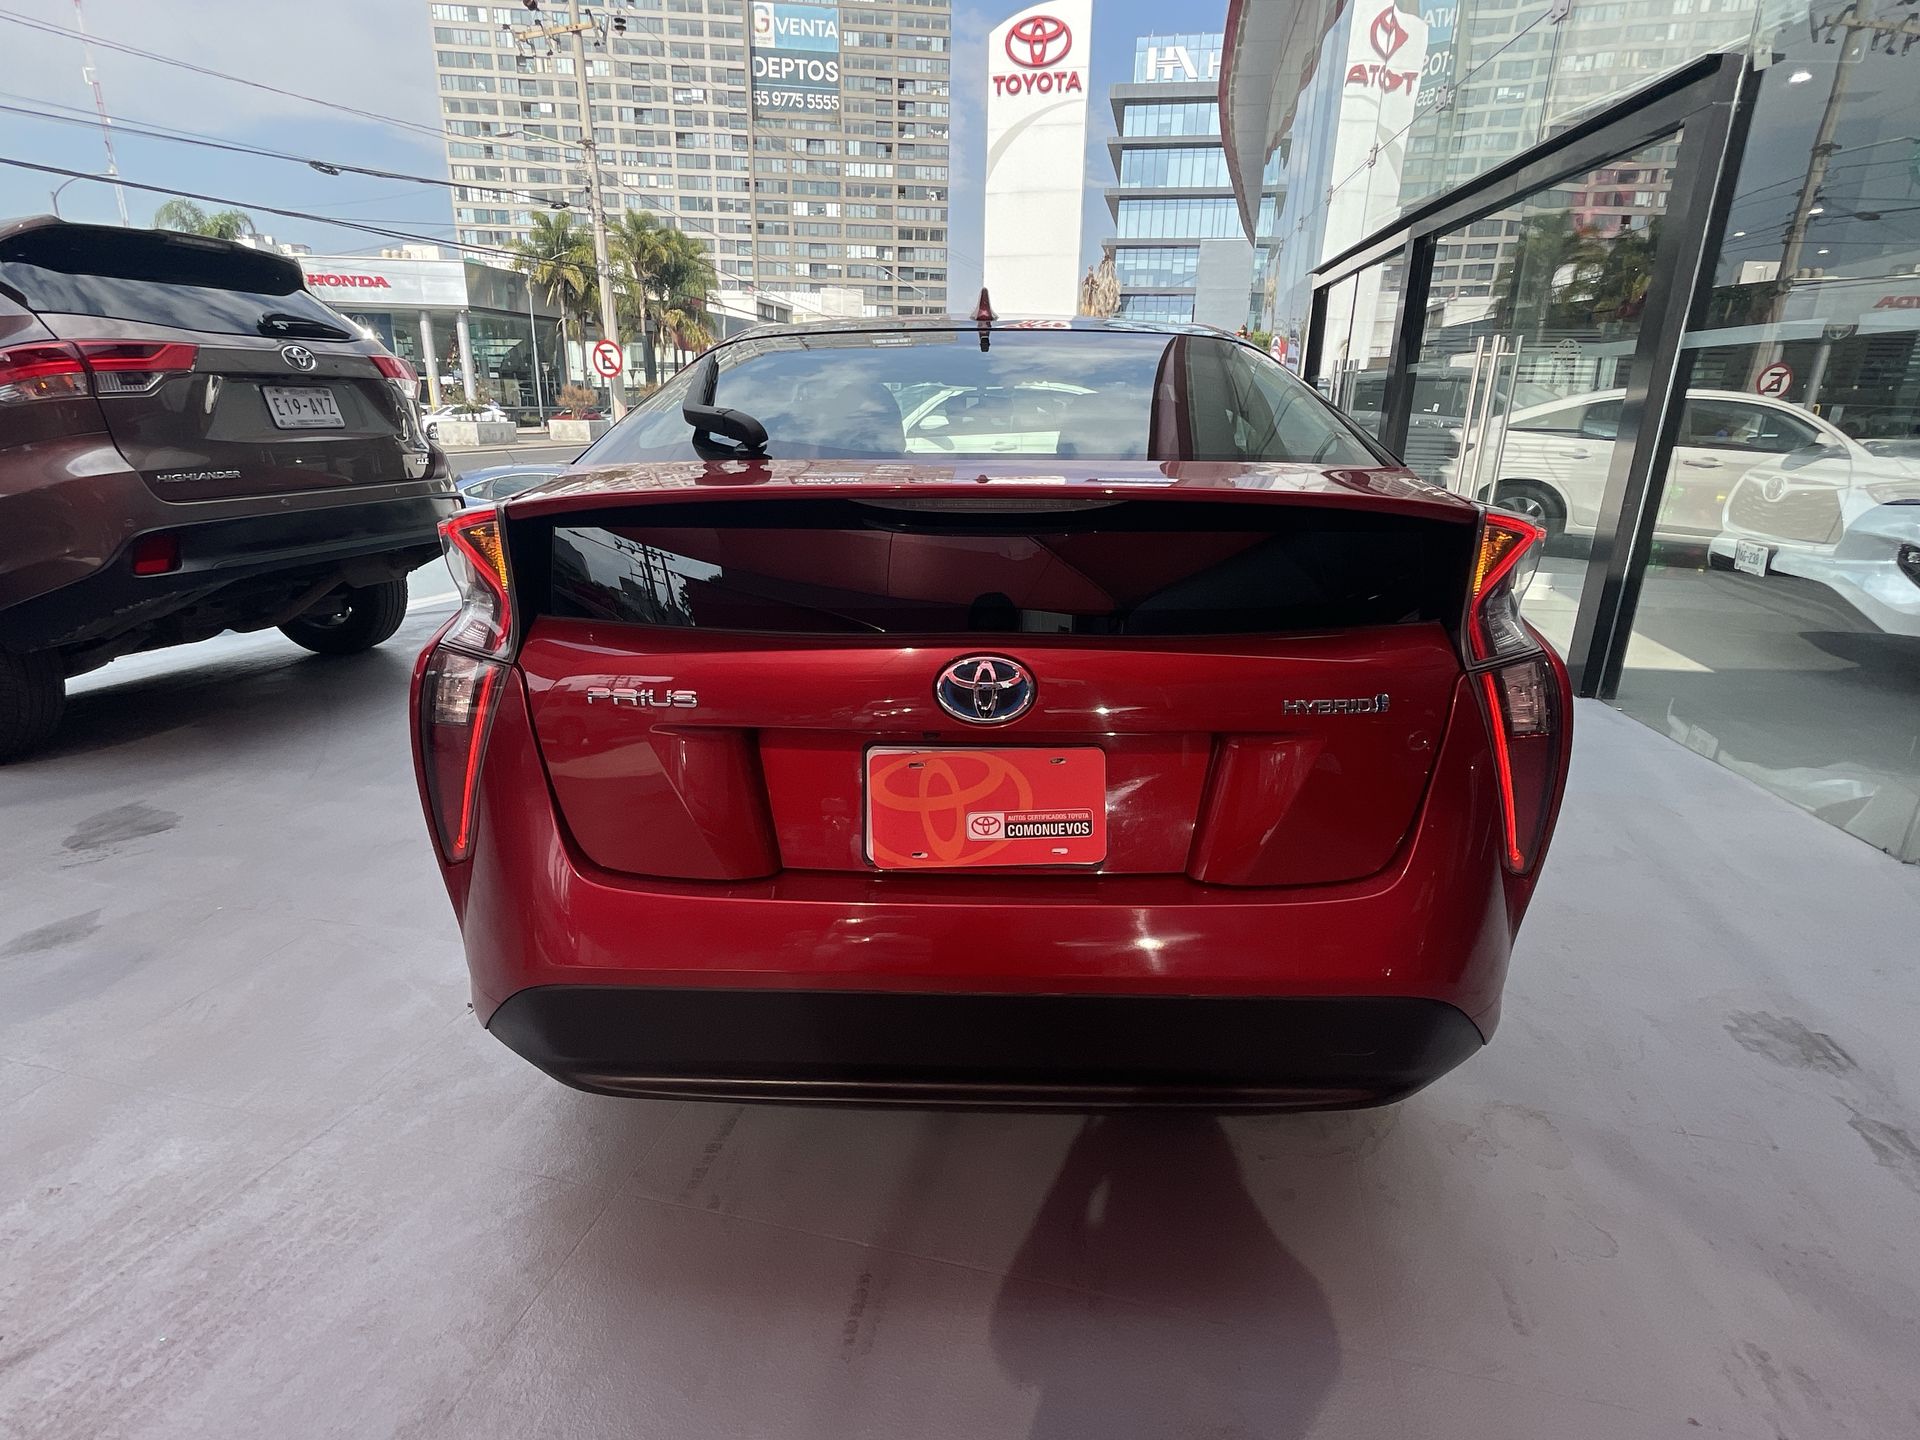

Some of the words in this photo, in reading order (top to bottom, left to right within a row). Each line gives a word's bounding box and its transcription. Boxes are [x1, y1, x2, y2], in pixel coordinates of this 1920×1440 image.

[775, 16, 839, 39] VENTA
[752, 56, 839, 82] DEPTOS
[993, 71, 1082, 97] TOYOTA
[753, 90, 769, 105] 55
[771, 91, 804, 108] 9775
[806, 93, 839, 110] 5555
[306, 274, 391, 288] HONDA
[602, 349, 615, 370] E
[272, 397, 336, 417] E19-AYZ
[157, 470, 241, 481] HIGHLANDER
[587, 687, 697, 708] PRIUS
[1283, 698, 1373, 715] HYBRID
[1027, 813, 1067, 821] CERTIFICADOS
[1068, 812, 1089, 820] TOYOTA
[1007, 822, 1090, 837] COMONUEVOS
